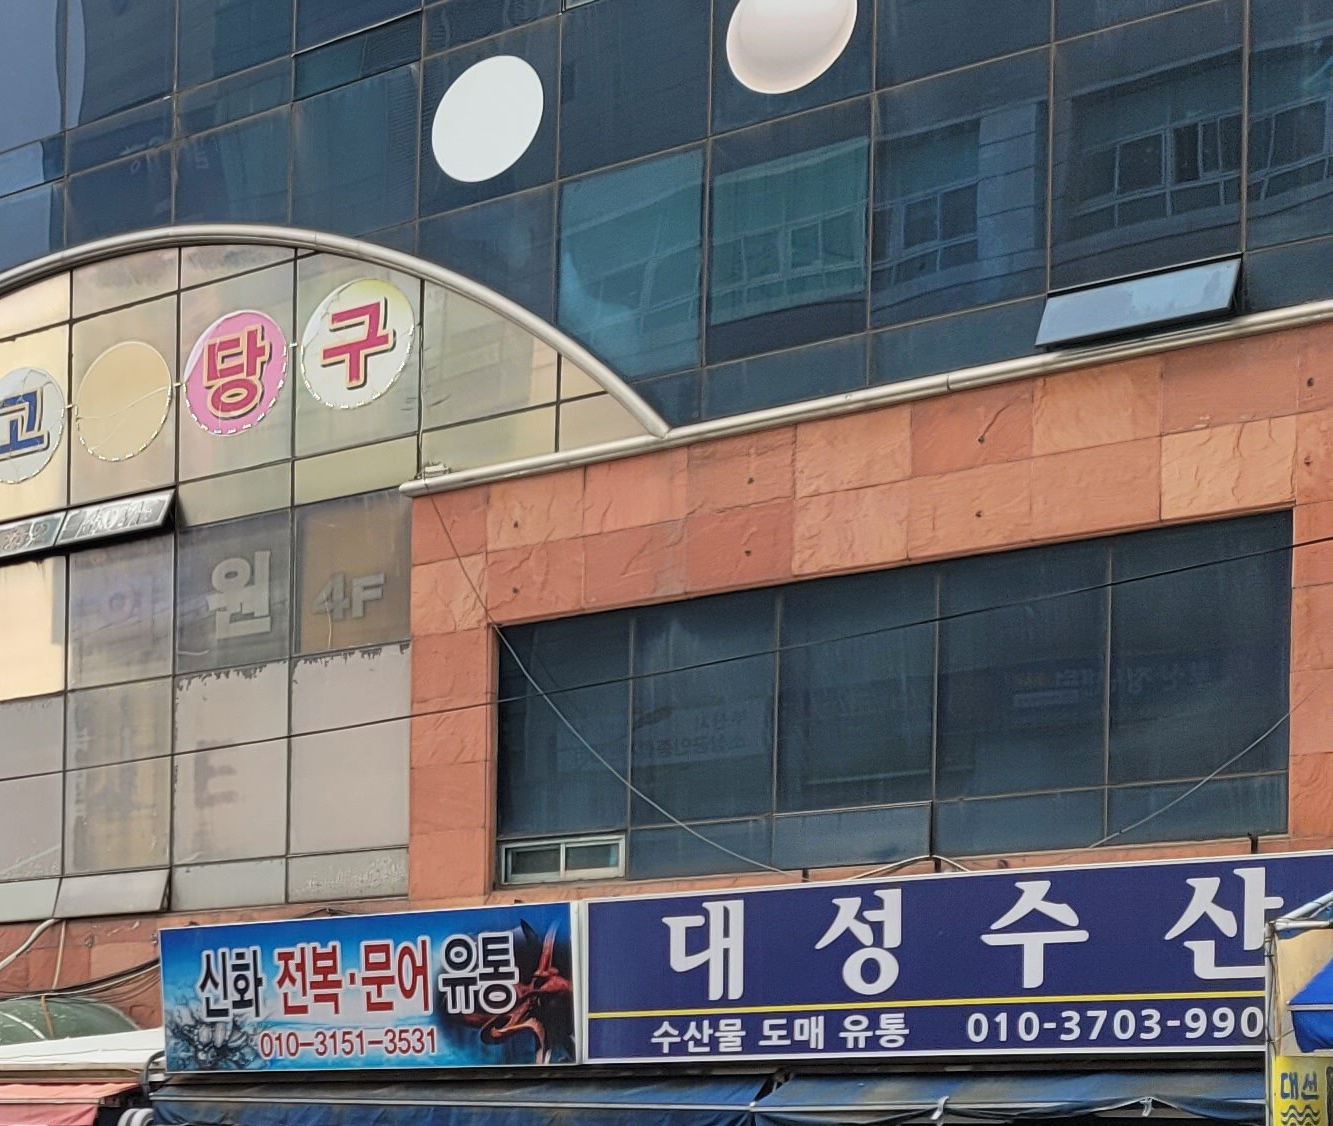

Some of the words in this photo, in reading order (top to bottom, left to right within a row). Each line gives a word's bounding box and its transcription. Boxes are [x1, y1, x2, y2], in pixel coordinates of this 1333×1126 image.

[661, 866, 1284, 1001] 대성수산
[199, 946, 263, 1020] 신화
[439, 932, 520, 1015] 유통
[260, 1027, 438, 1058] 010-3151-3531
[650, 1017, 747, 1054] 수산물
[757, 1013, 825, 1050] 도매
[838, 1012, 910, 1050] 유통
[1280, 1071, 1319, 1101] 대선
